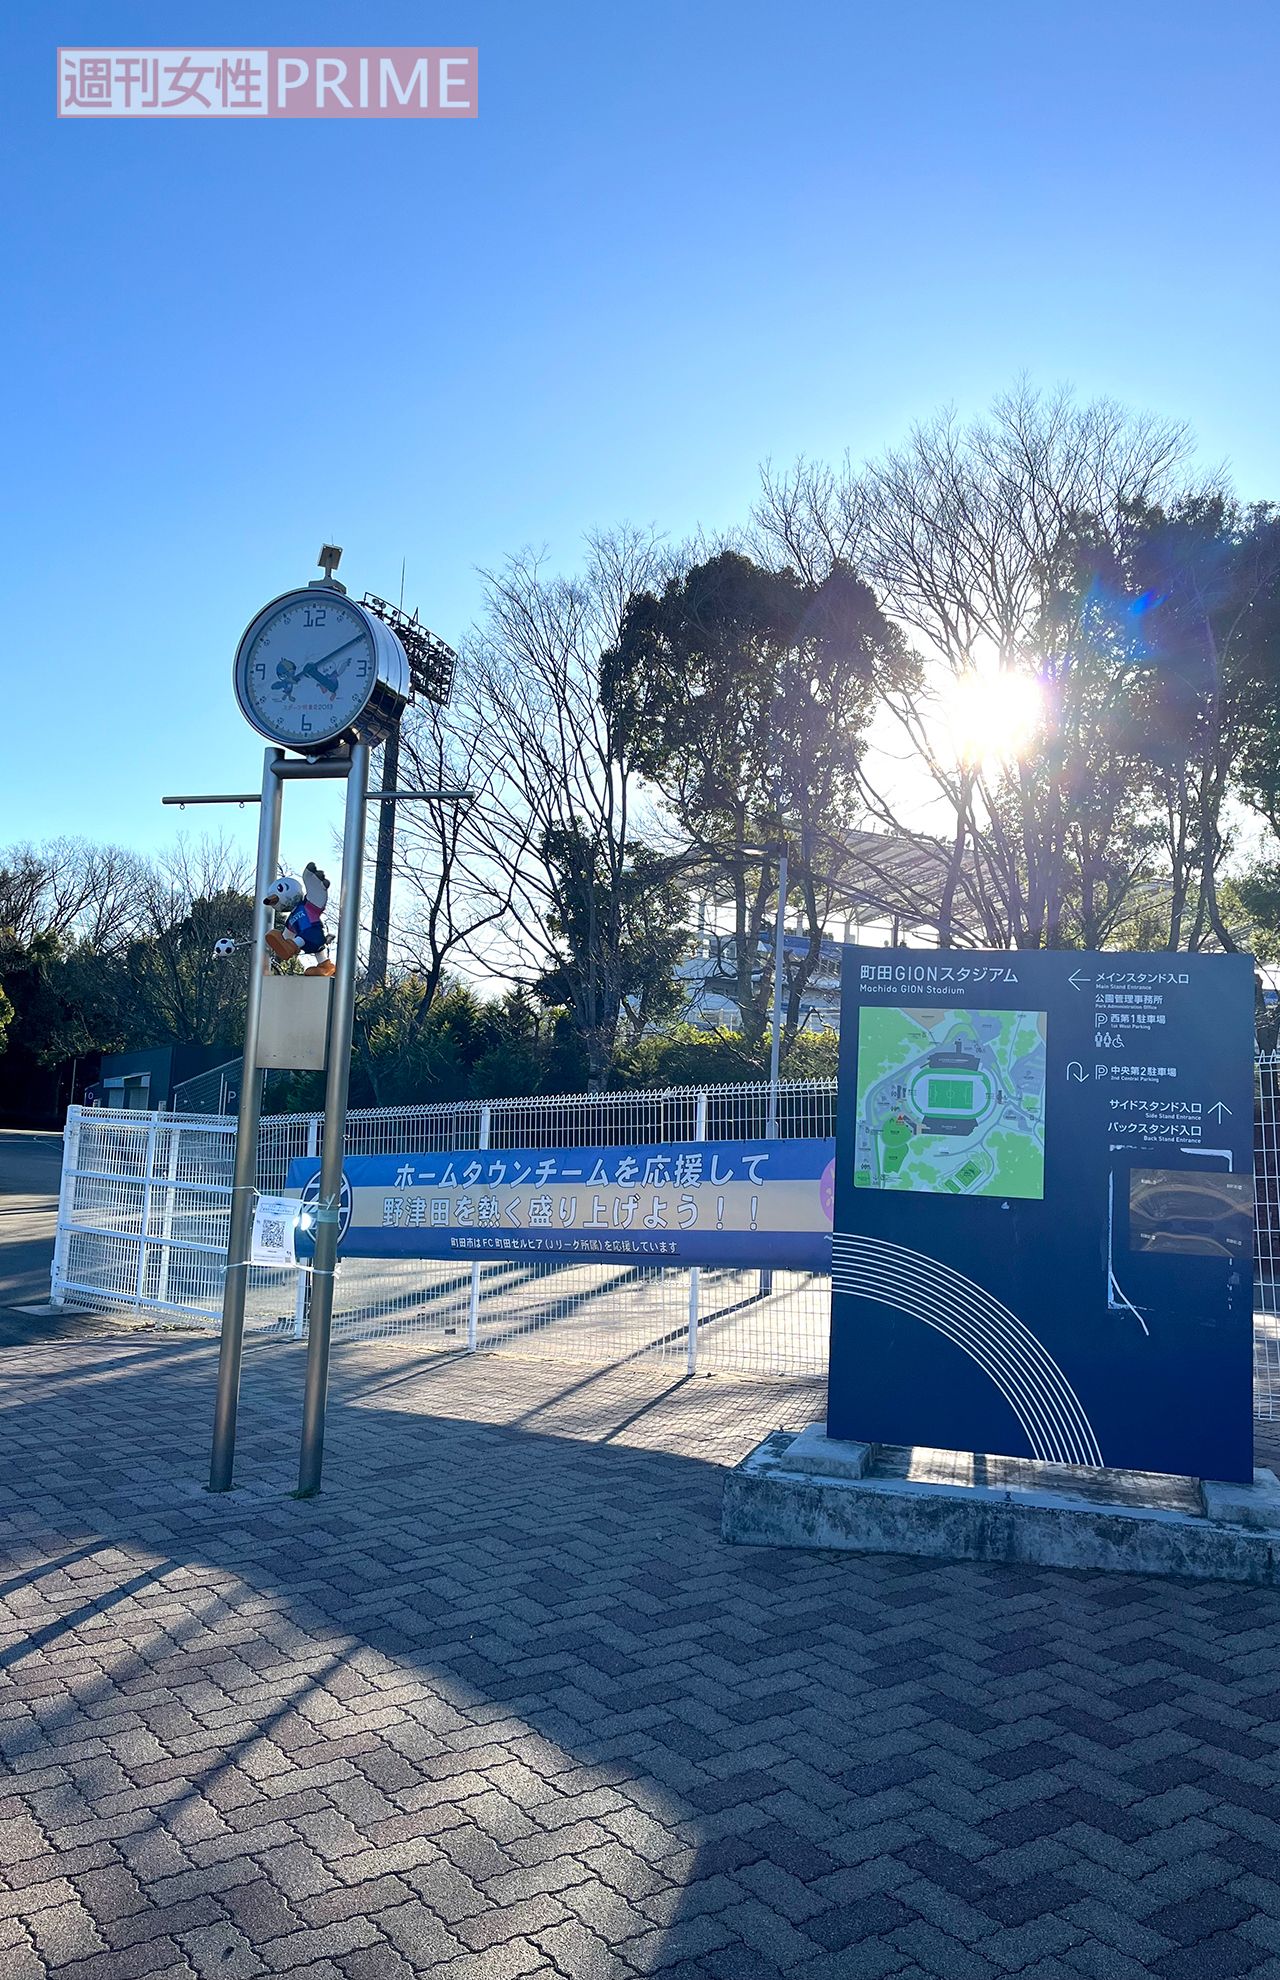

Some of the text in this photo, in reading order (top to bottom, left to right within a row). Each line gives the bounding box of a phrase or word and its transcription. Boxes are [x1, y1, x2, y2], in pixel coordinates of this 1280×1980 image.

[303, 609, 326, 627] 12
[255, 663, 266, 680] 9
[356, 660, 367, 677] 3
[301, 714, 312, 731] 6
[860, 964, 1018, 983] 町田GIONスタジアム
[1096, 973, 1189, 984] メインスタンド入口
[860, 984, 965, 995] Machida GION Stadium
[1110, 1066, 1177, 1077] 中央第2駐車場
[1110, 1099, 1202, 1113] サイドスタンド入口
[1108, 1122, 1202, 1136] バックスタンド入口
[393, 1153, 769, 1190] ホームタウンチームを応援して
[382, 1194, 759, 1230] 野津田を熱く盛り上げよう！！
